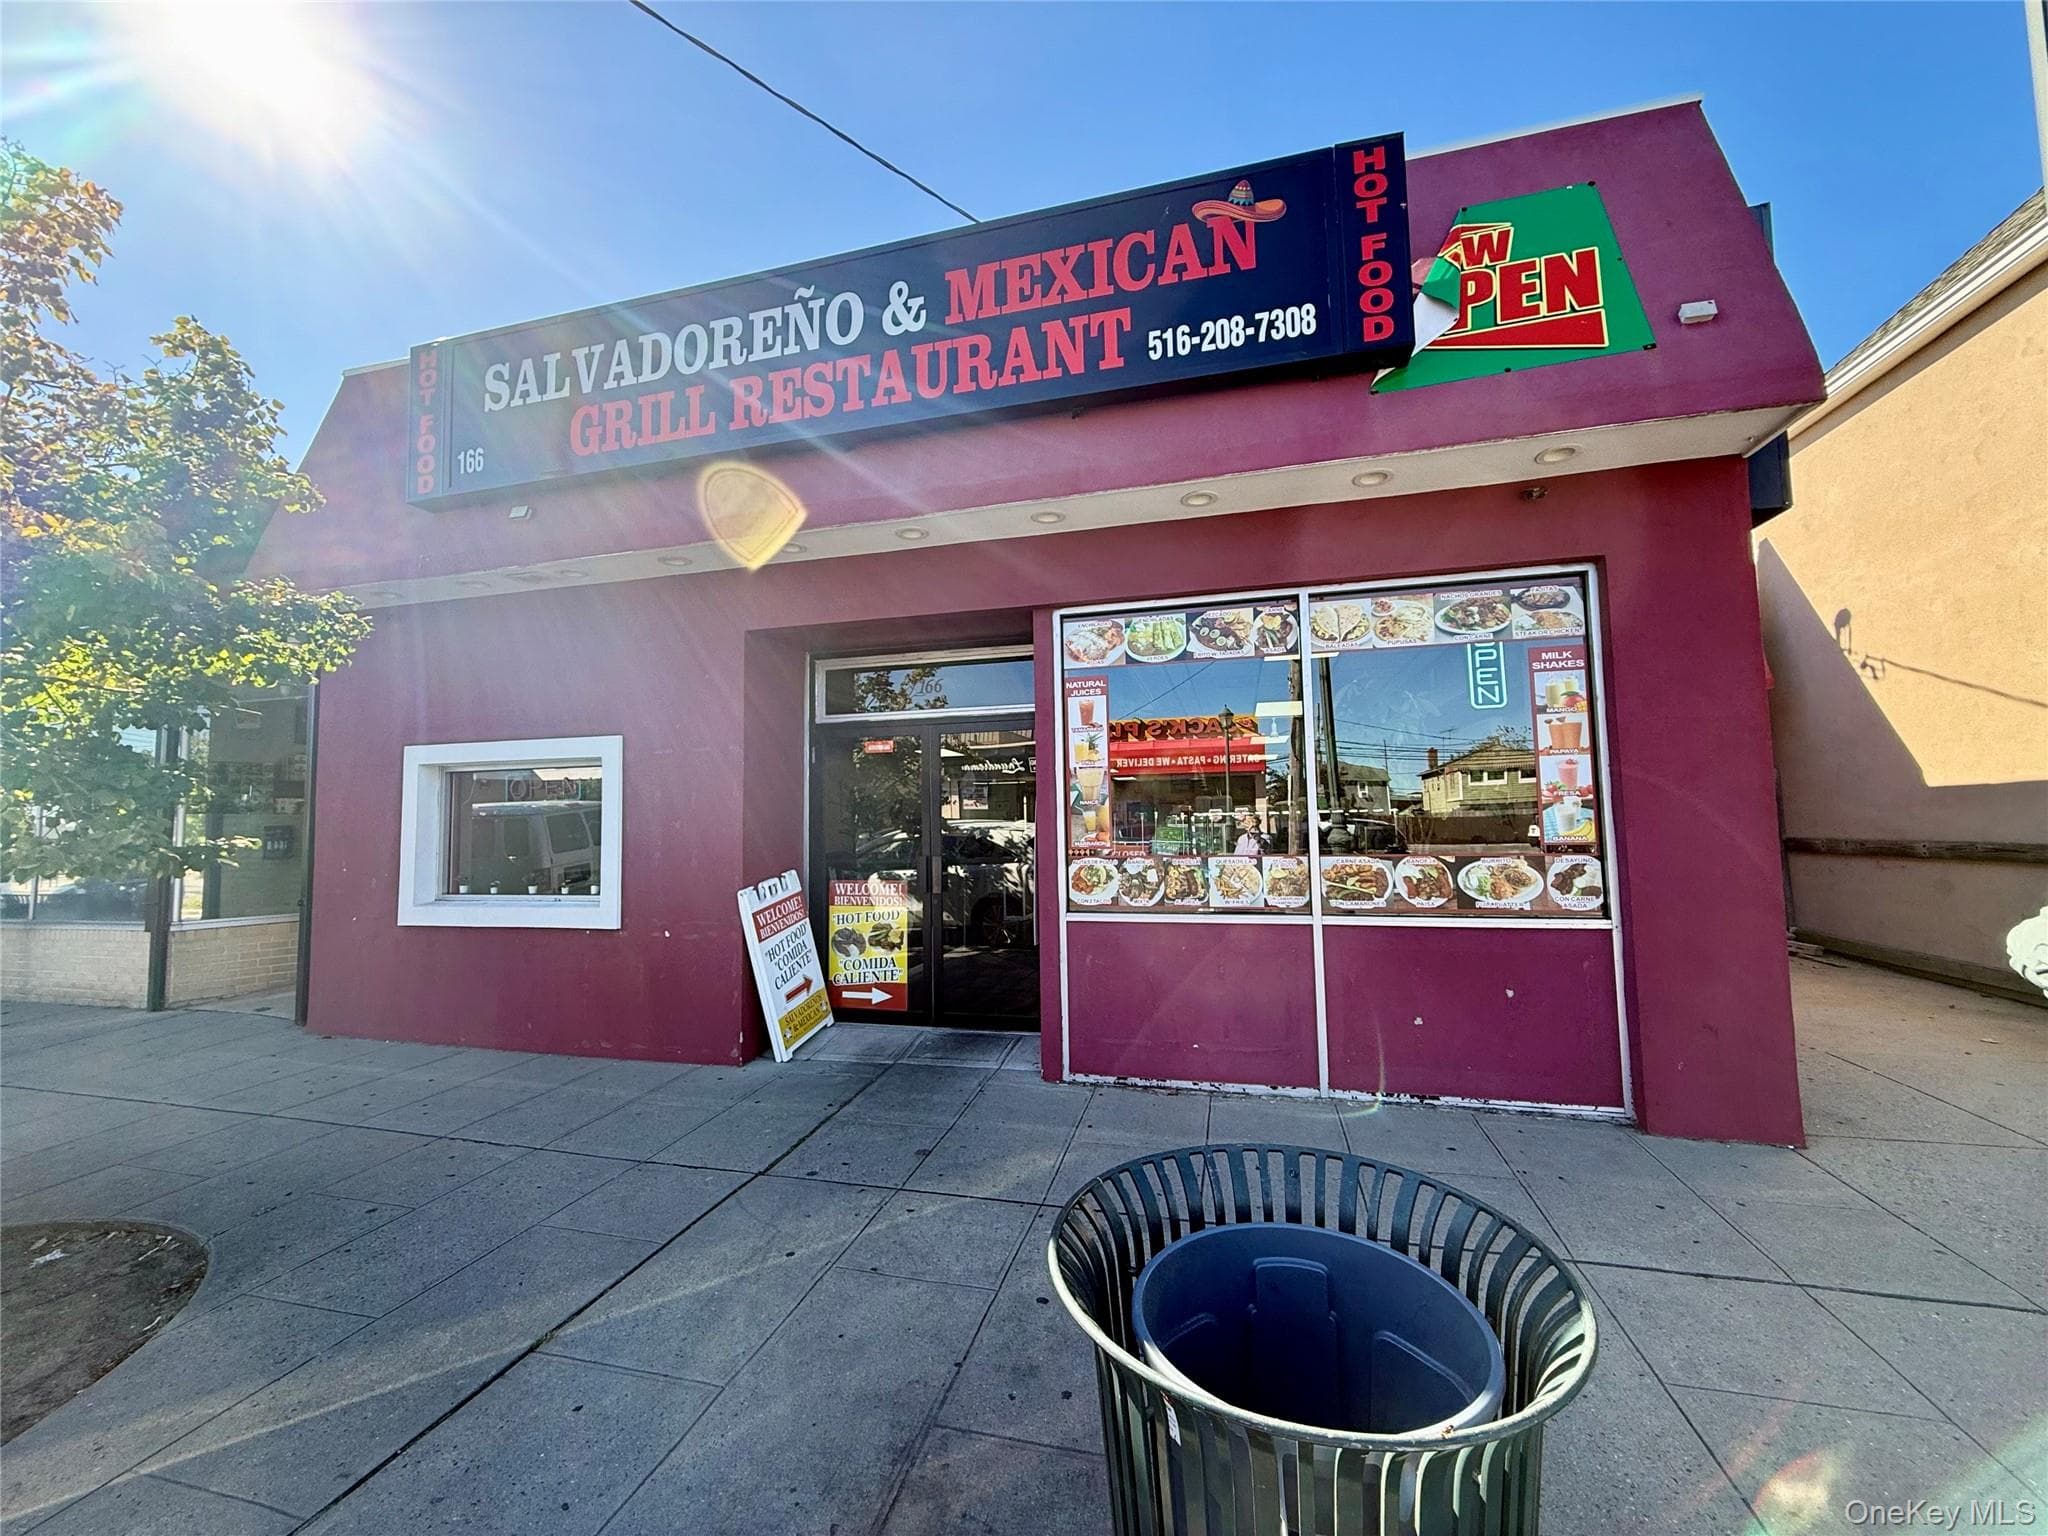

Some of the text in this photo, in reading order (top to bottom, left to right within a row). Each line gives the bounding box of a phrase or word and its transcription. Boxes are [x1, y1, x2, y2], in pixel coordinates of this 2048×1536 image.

[1352, 147, 1395, 343] HOT FOOD
[1446, 247, 1603, 334] PEN
[482, 216, 1259, 412] SALVADOREÑO & MEXICAN
[1147, 303, 1317, 361] 516-208-7308
[569, 308, 1132, 457] GRILL RESTAURANT
[416, 350, 438, 495] HOT FOOD
[457, 447, 484, 475] 166
[1532, 660, 1585, 670] SHAKES
[1541, 651, 1572, 660] MILK
[1065, 680, 1107, 689] NATURAL
[1474, 641, 1500, 705] PEN
[1071, 688, 1102, 697] JUICES
[834, 882, 903, 896] WELCOME!
[834, 895, 903, 906] BIENVENIDOS!
[756, 895, 803, 927] WELCOME!
[759, 909, 805, 940] BIENVENIDOS!
[833, 969, 903, 985] CALIENTE"
[840, 957, 897, 971] "COMIDA
